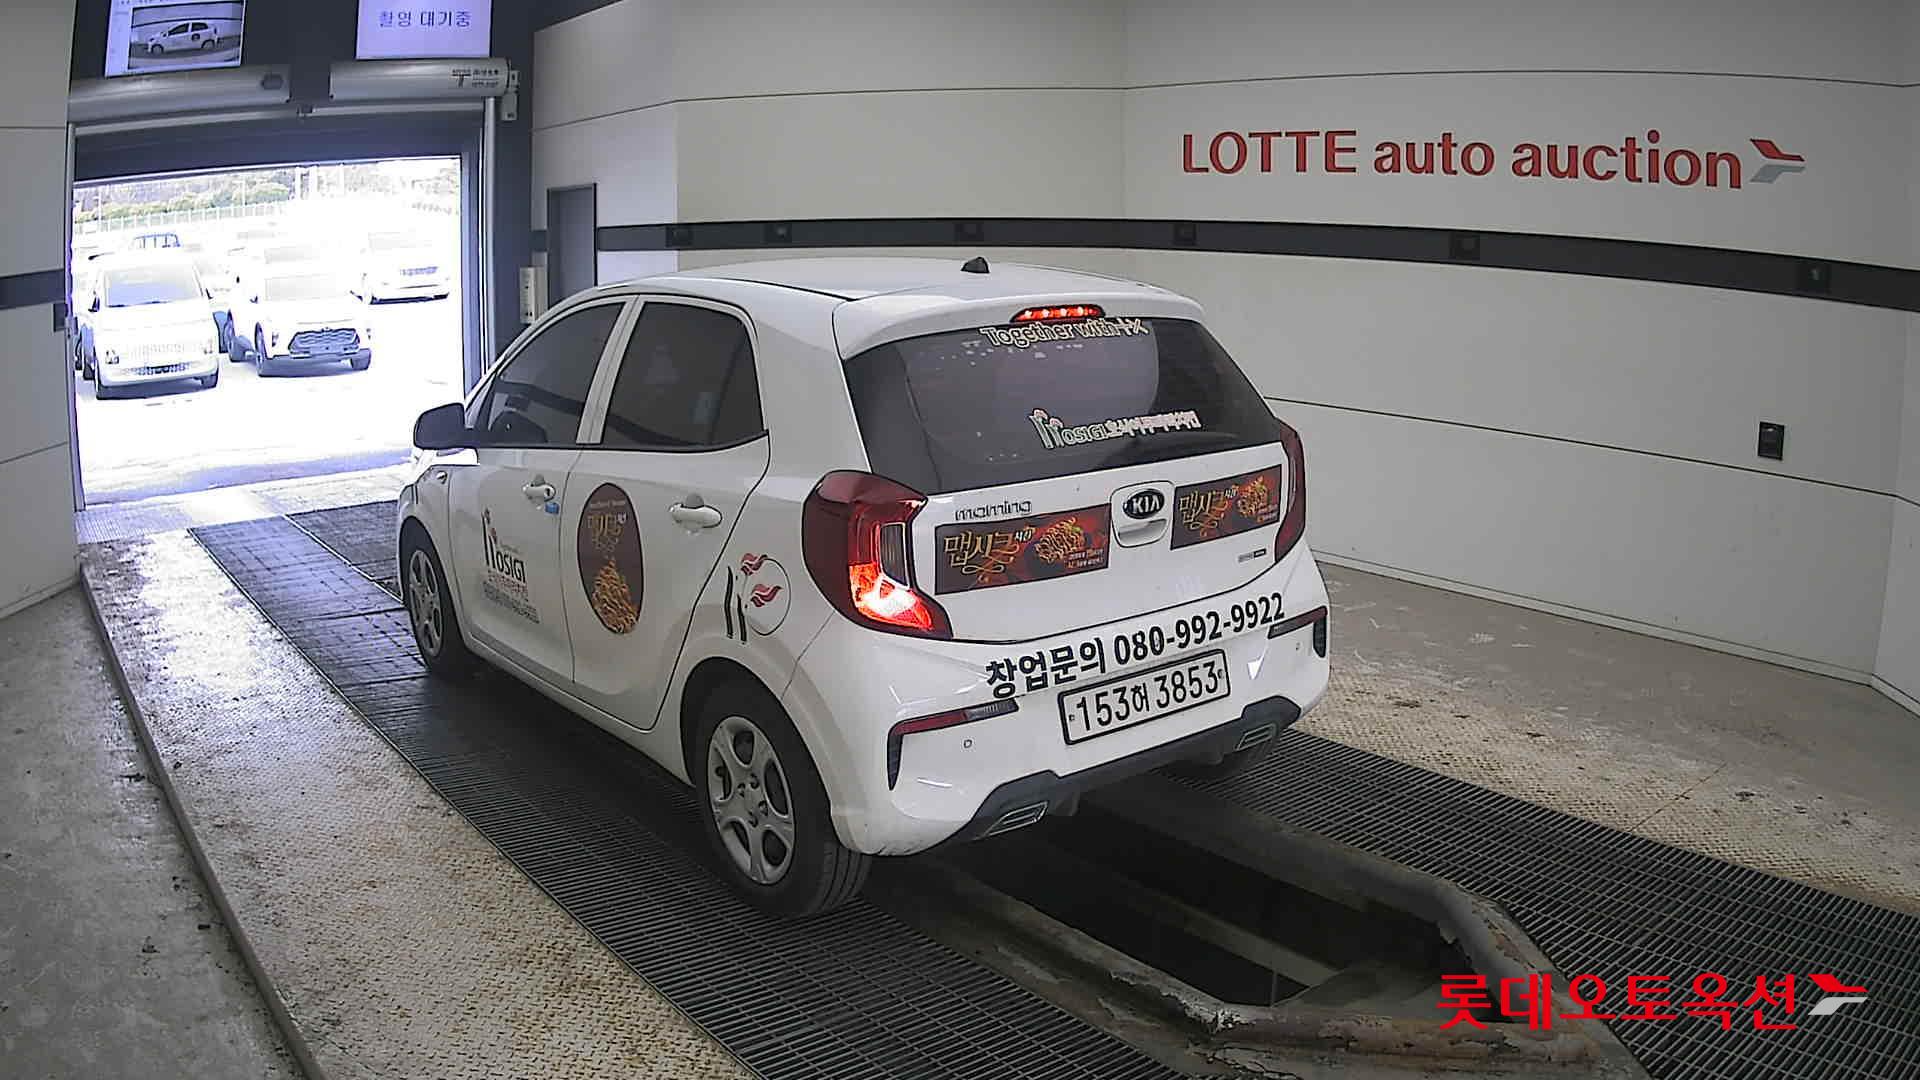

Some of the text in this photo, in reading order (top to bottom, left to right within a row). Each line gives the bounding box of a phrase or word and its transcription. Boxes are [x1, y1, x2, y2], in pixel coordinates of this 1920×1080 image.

[420, 11, 471, 28] 대기중
[1182, 129, 1742, 190] LOTTE auto auction
[979, 322, 1076, 348] Together
[1132, 493, 1162, 514] KIA
[985, 592, 1285, 699] 창업문의 080-992-9922
[1076, 659, 1218, 731] 153허 3853
